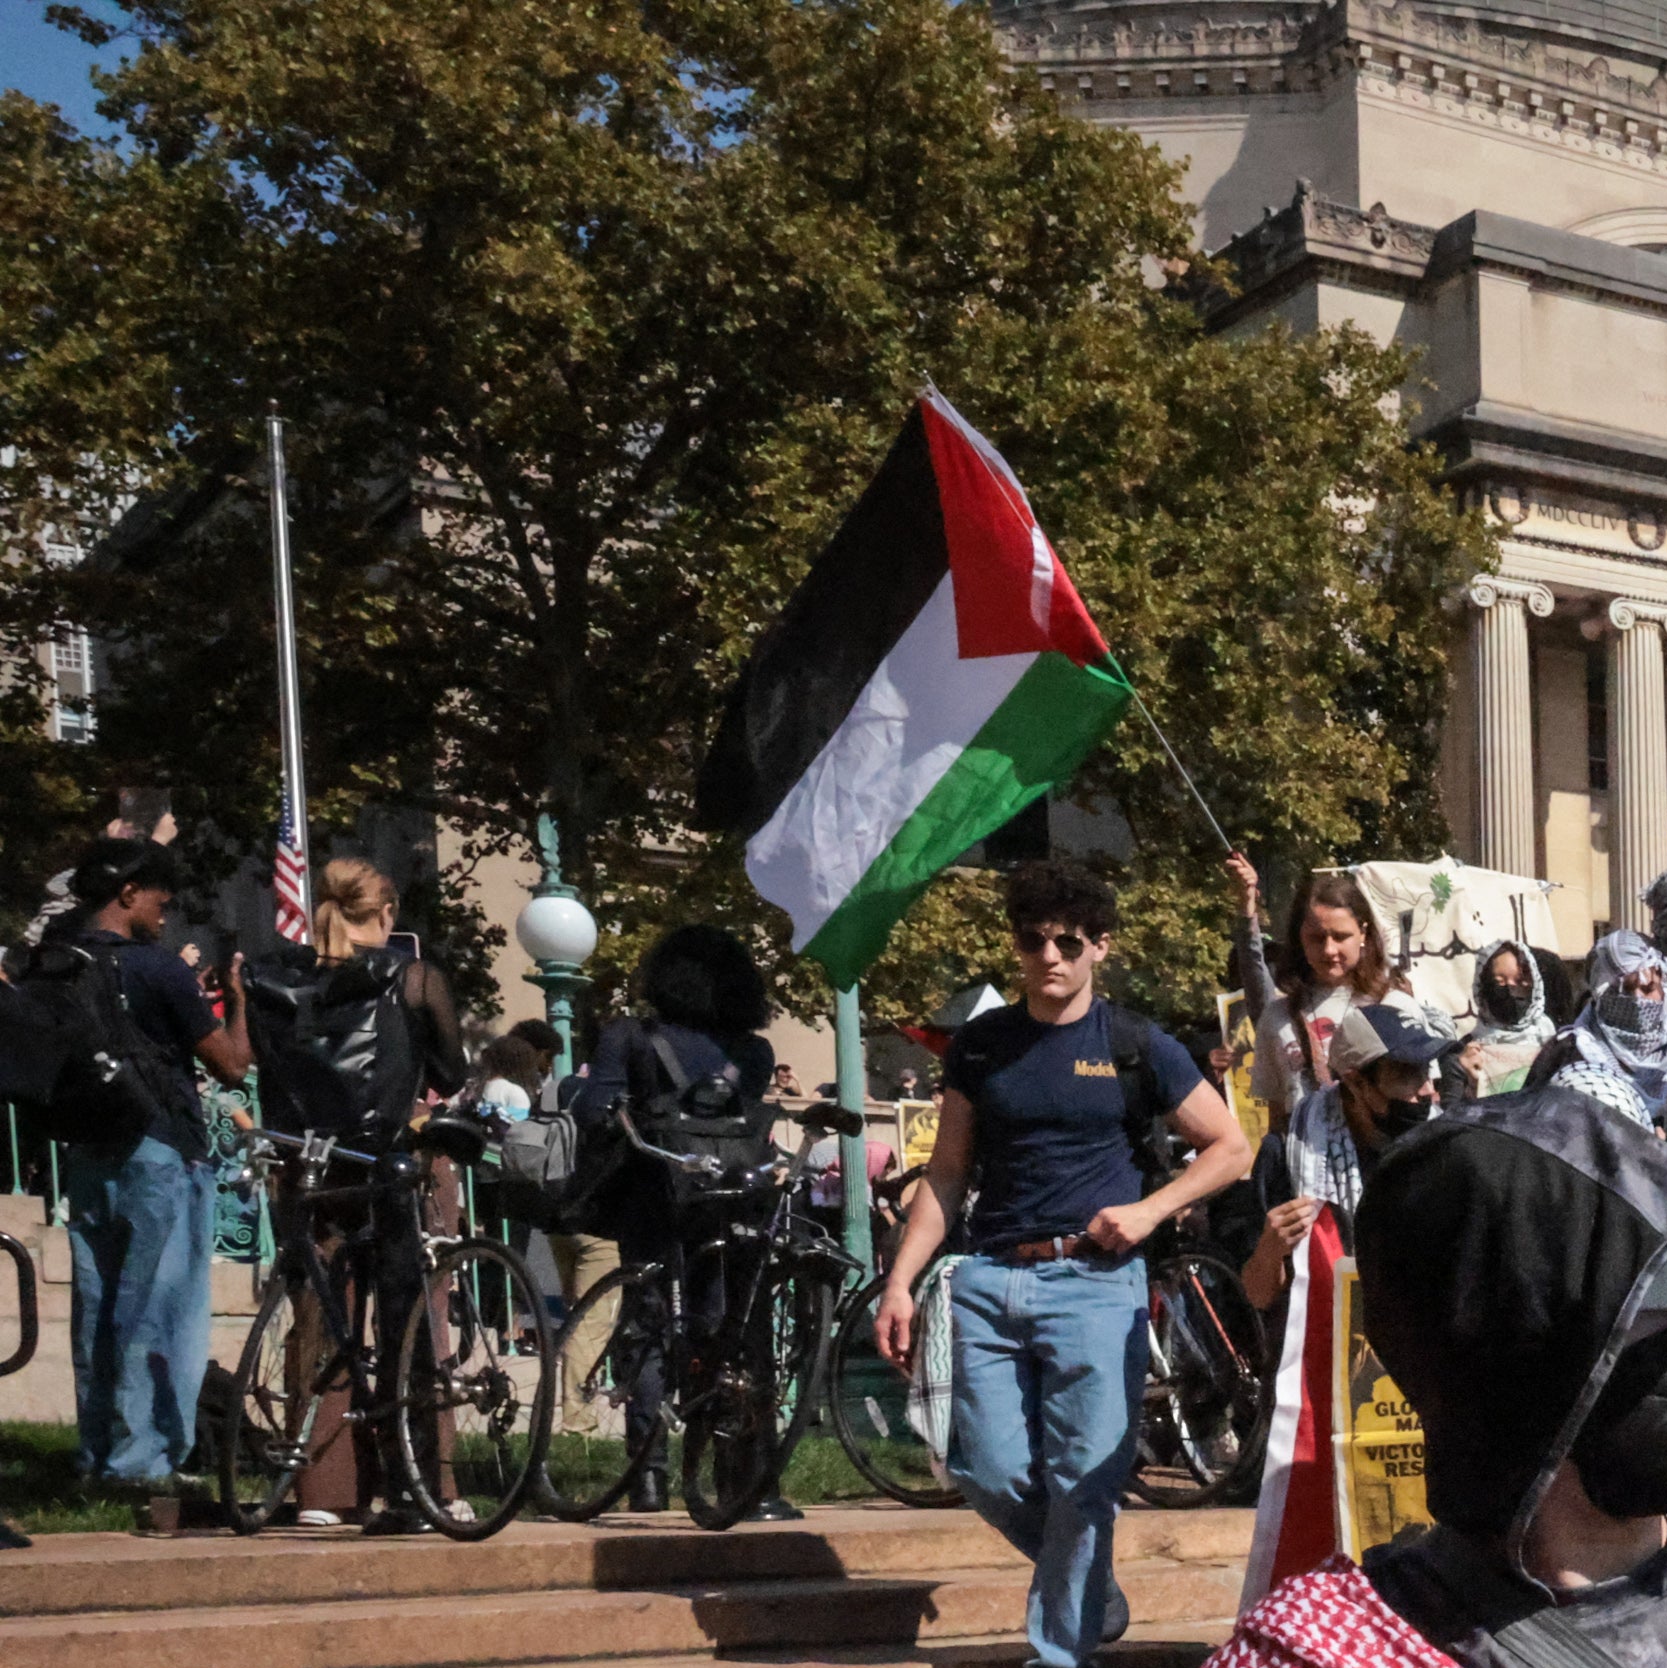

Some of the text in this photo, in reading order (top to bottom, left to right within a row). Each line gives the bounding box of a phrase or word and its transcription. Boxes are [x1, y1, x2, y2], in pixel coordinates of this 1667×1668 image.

[1536, 503, 1619, 531] MDCCLIV
[1074, 1060, 1117, 1078] Model
[1375, 1401, 1416, 1418] GLO
[1396, 1418, 1424, 1433] MA
[1366, 1443, 1424, 1461] VICTO
[1385, 1461, 1424, 1478] RES
